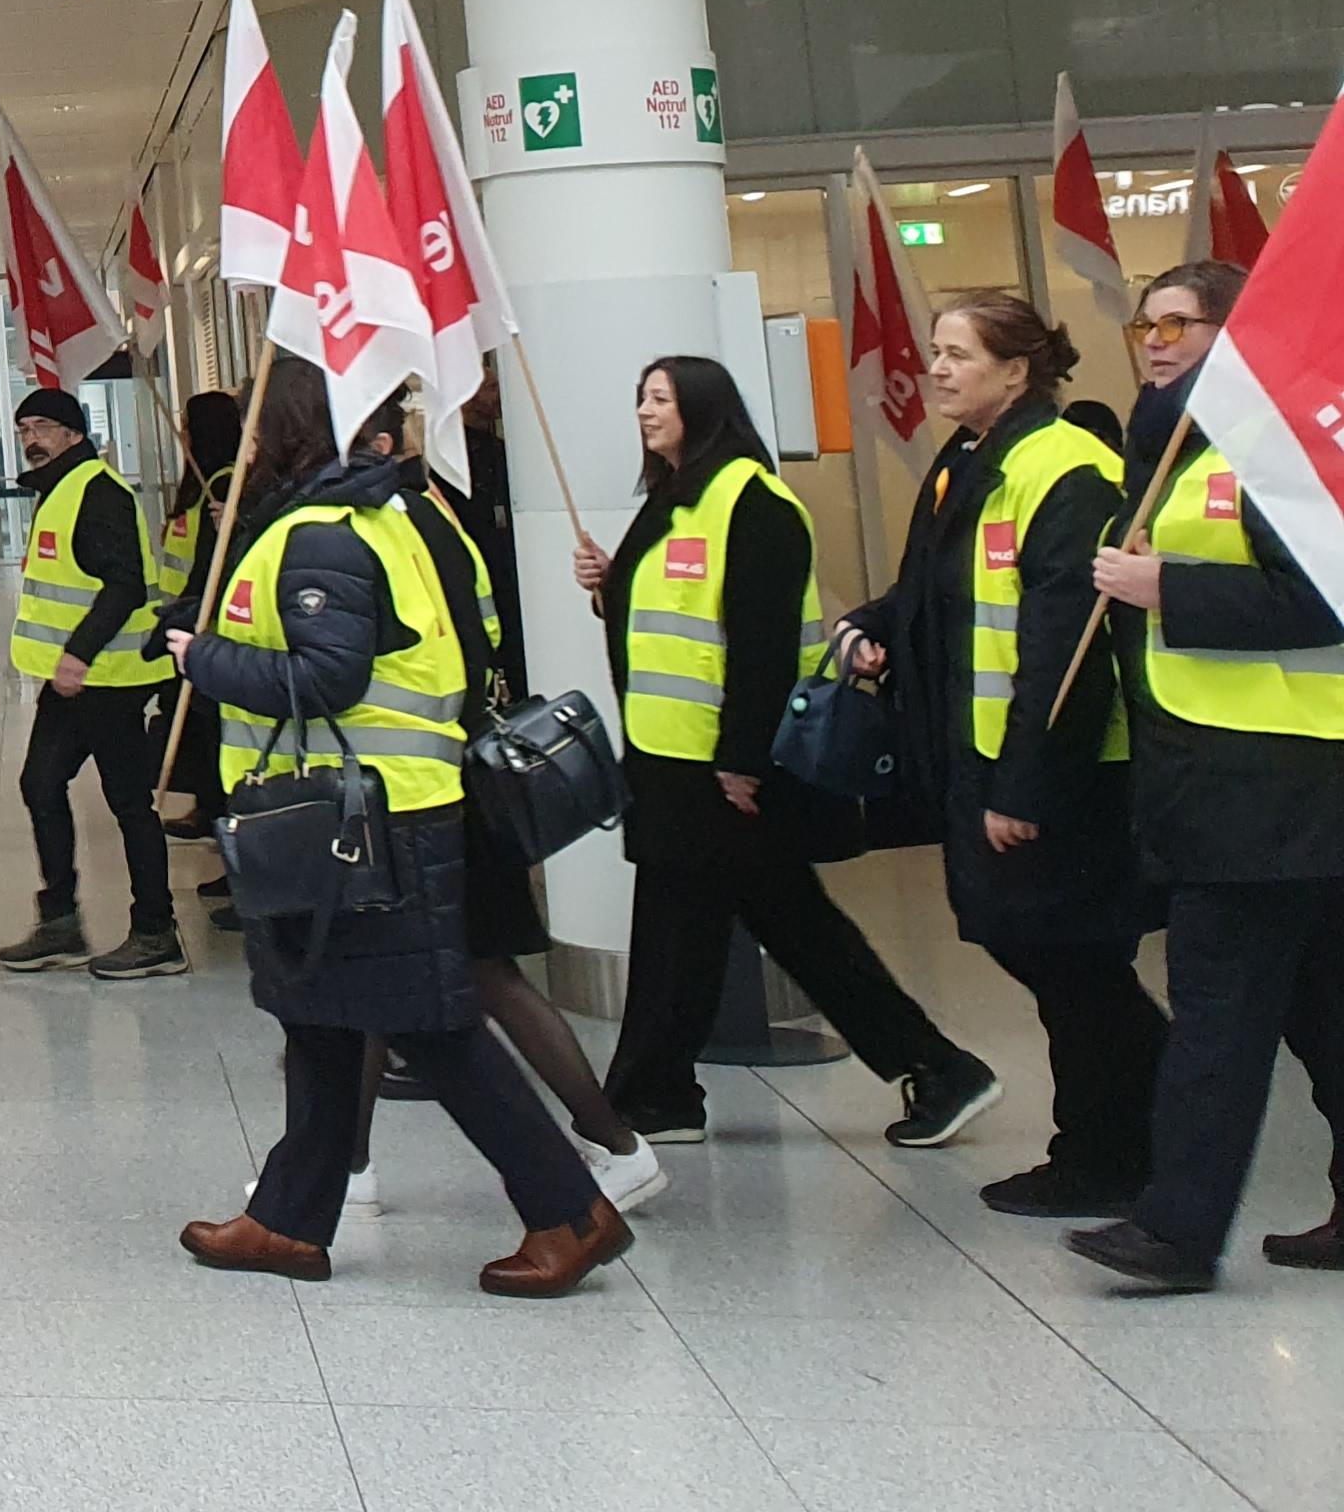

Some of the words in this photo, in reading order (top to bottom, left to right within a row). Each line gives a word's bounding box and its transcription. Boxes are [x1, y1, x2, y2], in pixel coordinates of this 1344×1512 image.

[652, 80, 679, 96] AED
[486, 94, 505, 111] AED
[647, 97, 687, 113] Notruf
[483, 109, 512, 128] Notruf
[659, 115, 680, 130] 112
[491, 128, 506, 143] 112
